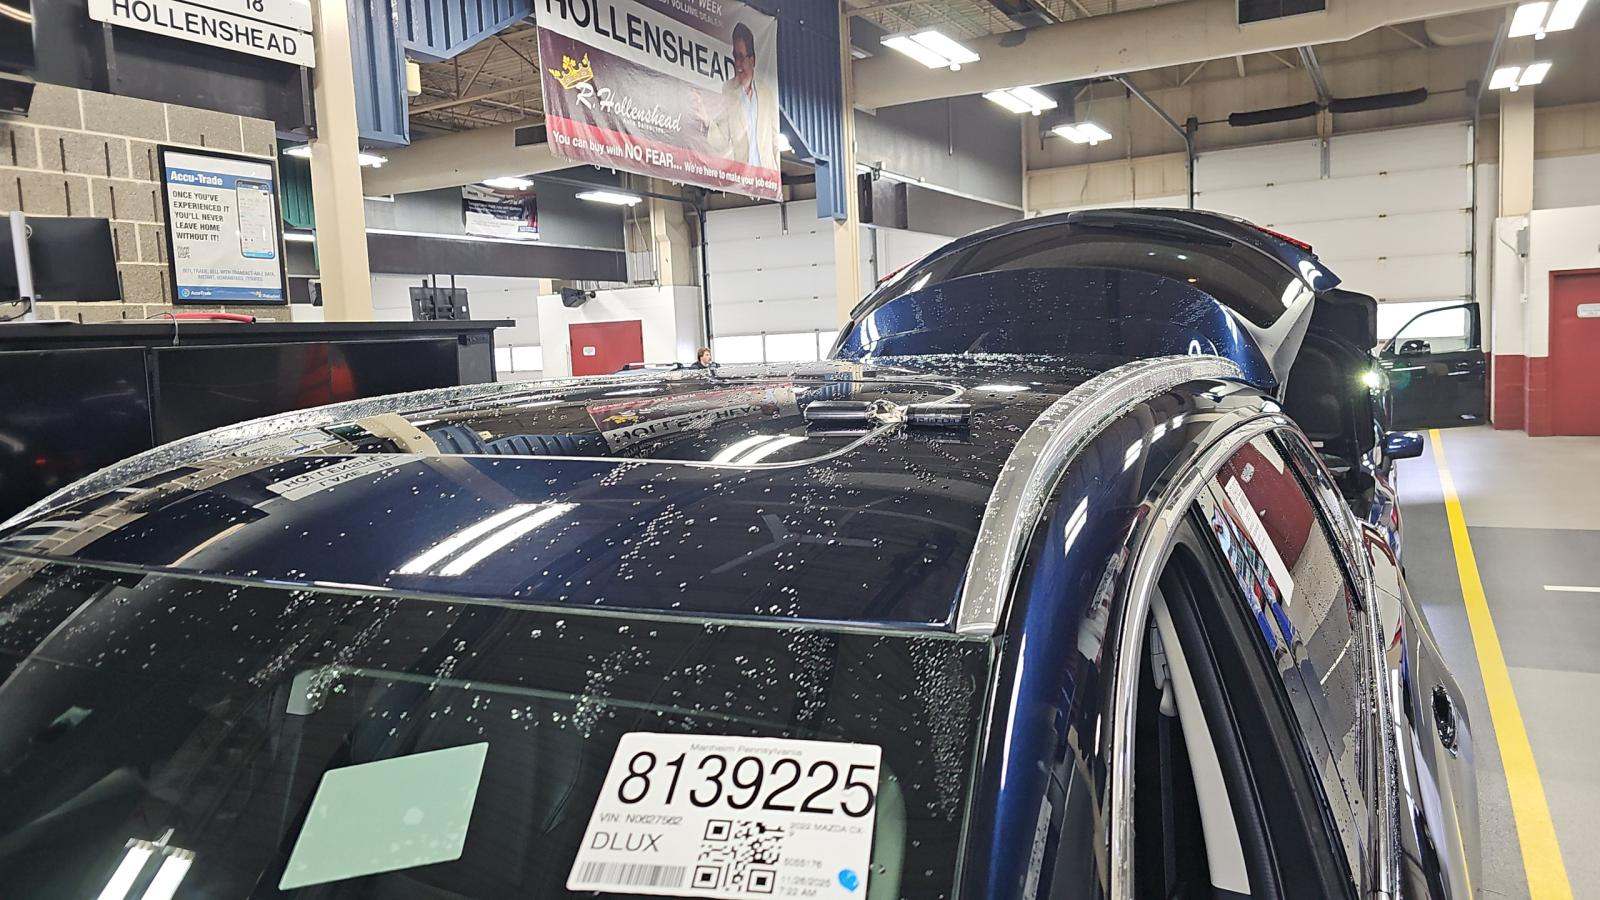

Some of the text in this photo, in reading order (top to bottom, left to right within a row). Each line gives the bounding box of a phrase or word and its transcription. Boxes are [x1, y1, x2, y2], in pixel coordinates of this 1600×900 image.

[112, 0, 297, 56] HOLLENSHEAD
[597, 87, 681, 132] Hollenshead
[552, 130, 571, 146] You
[572, 137, 588, 149] can
[589, 139, 605, 155] buy
[606, 145, 624, 158] with
[625, 142, 643, 162] NO
[704, 166, 719, 177] here
[719, 170, 726, 179] to
[170, 170, 224, 186] Accu-Trade
[172, 190, 219, 202] ONCE YOU'VE
[173, 201, 230, 213] EXPERIENCED IT
[174, 211, 224, 222] YOU'LL NEVER
[175, 221, 221, 232] LEAVE HOME
[176, 232, 208, 241] WITHOUT
[617, 750, 876, 818] 8139225
[591, 831, 664, 852] DLUX
